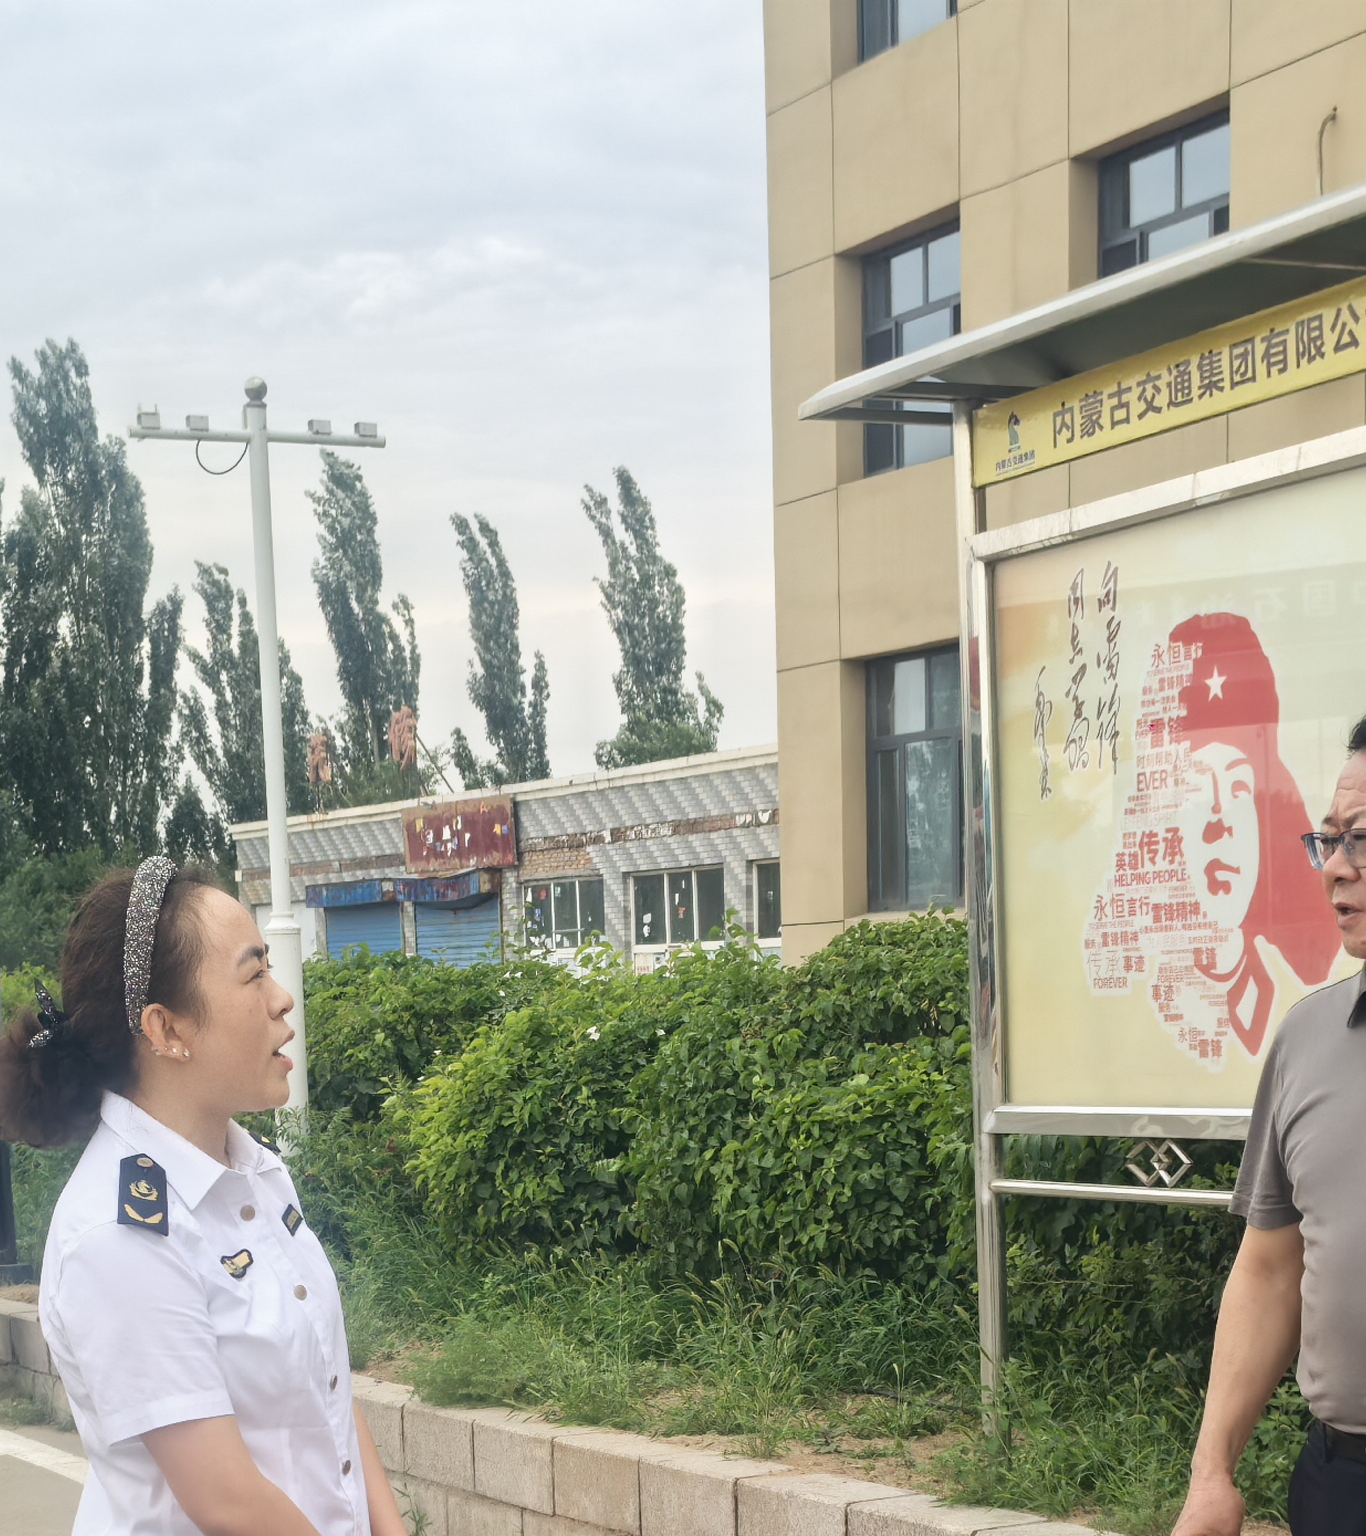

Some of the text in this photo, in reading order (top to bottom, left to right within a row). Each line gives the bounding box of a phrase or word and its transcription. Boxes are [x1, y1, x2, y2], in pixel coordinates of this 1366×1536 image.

[1137, 769, 1168, 792] EVER
[1139, 827, 1184, 868] 传承
[1115, 851, 1139, 872] 英雄
[1114, 871, 1151, 887] HELPING
[1094, 893, 1150, 921] 永恒言行
[1151, 899, 1201, 924] 雷锋精神
[1122, 955, 1145, 973] 事迹
[1178, 1027, 1198, 1043] 永恒
